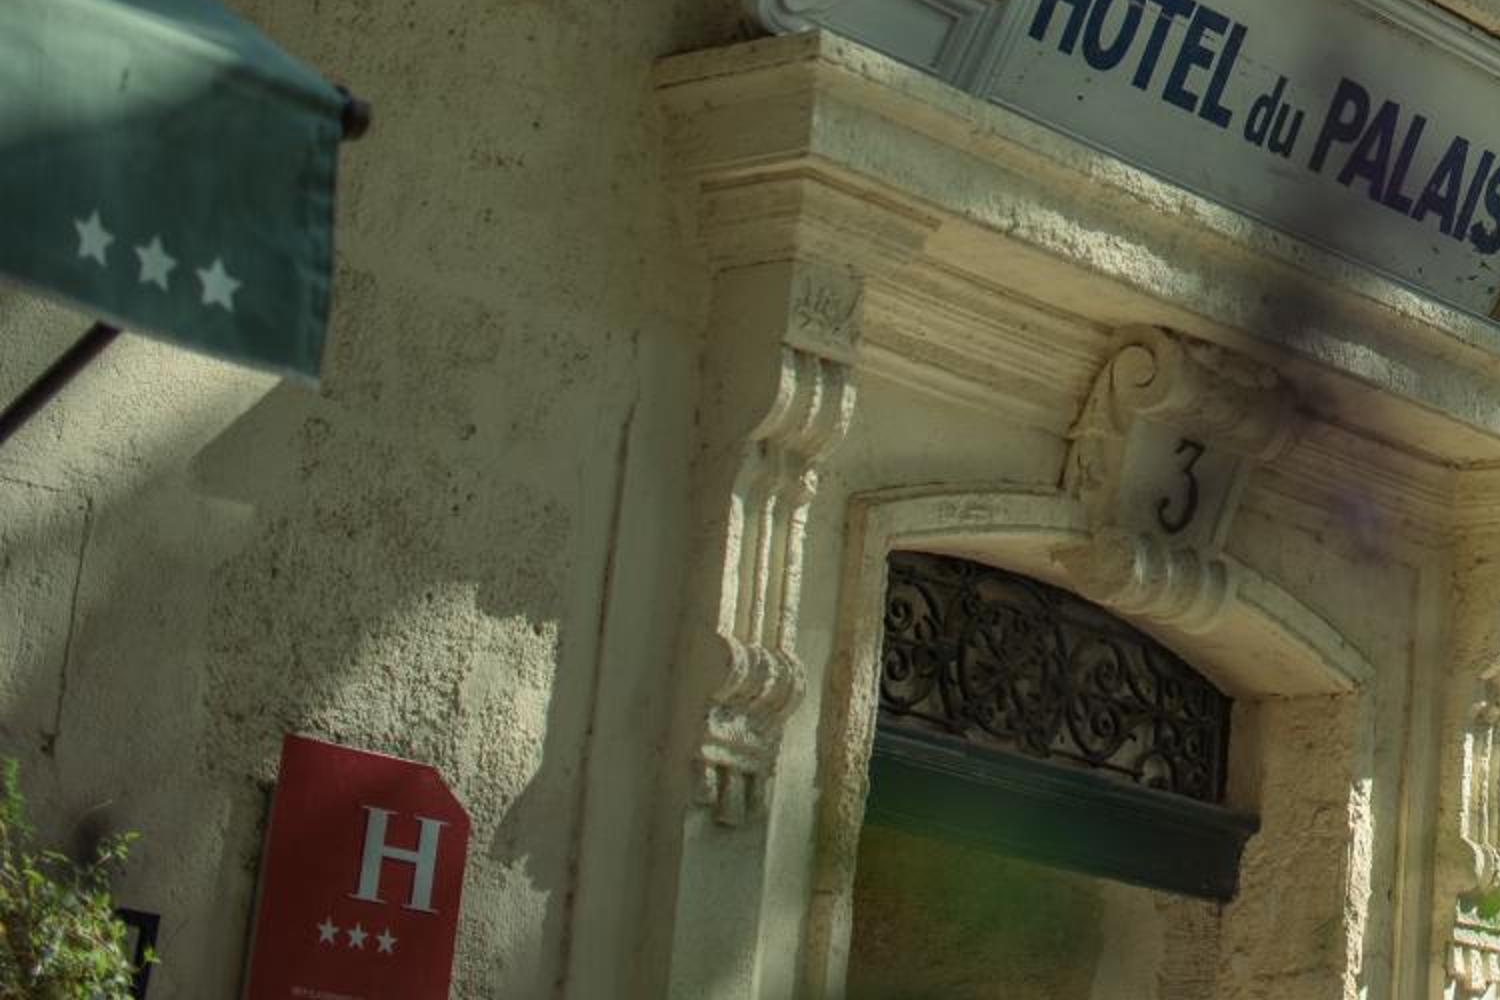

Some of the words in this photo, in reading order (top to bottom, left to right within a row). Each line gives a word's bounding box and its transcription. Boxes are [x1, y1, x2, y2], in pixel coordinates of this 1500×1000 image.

[1243, 76, 1305, 159] du
[1157, 438, 1206, 534] 3
[347, 804, 449, 914] H
